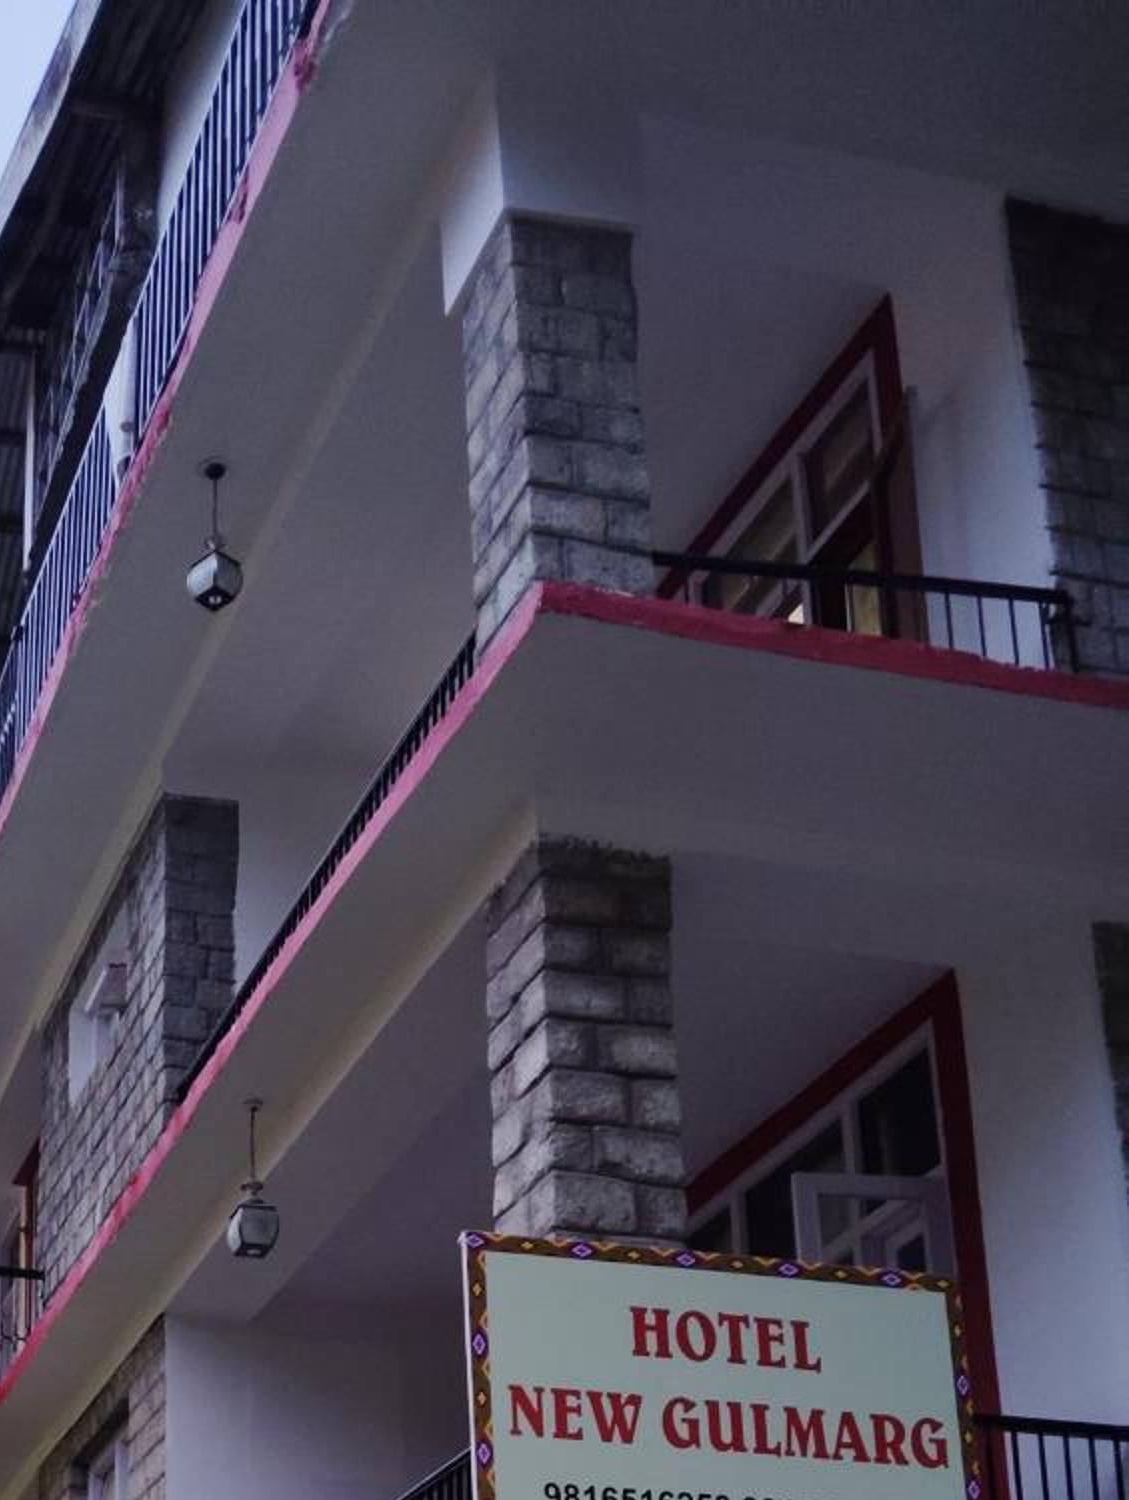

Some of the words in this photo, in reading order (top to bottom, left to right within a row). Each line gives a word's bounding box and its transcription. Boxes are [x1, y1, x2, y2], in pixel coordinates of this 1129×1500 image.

[630, 1305, 822, 1374] HOTEL
[508, 1385, 643, 1445] NEW
[661, 1396, 949, 1469] GULMARG
